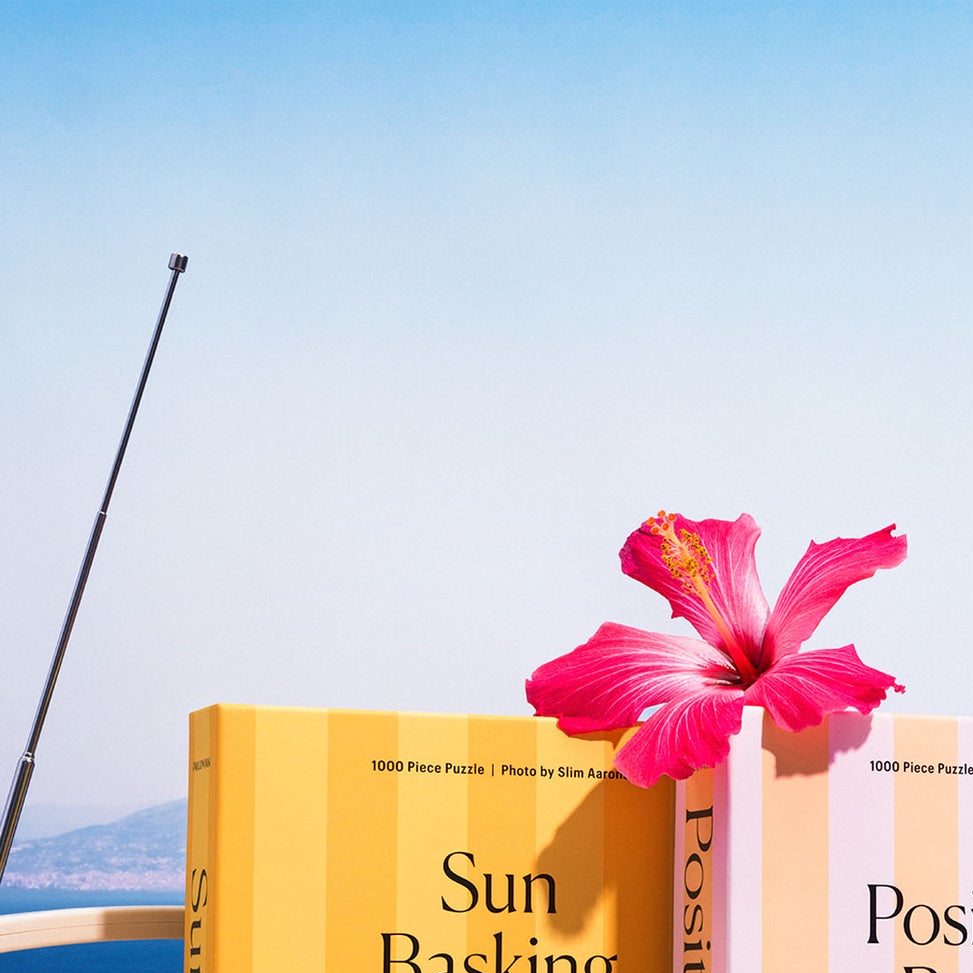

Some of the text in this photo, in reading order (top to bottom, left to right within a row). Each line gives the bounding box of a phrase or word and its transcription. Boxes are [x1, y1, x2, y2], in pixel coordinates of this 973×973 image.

[371, 760, 404, 772] 1000
[407, 761, 442, 774] Piece
[445, 762, 485, 775] Puzzle
[501, 764, 537, 777] Photo
[540, 765, 555, 780] by
[558, 766, 584, 778] Slim
[870, 760, 900, 773] 1000
[903, 761, 935, 774] Piece
[938, 762, 973, 775] Puzzle
[441, 851, 557, 914] Sun
